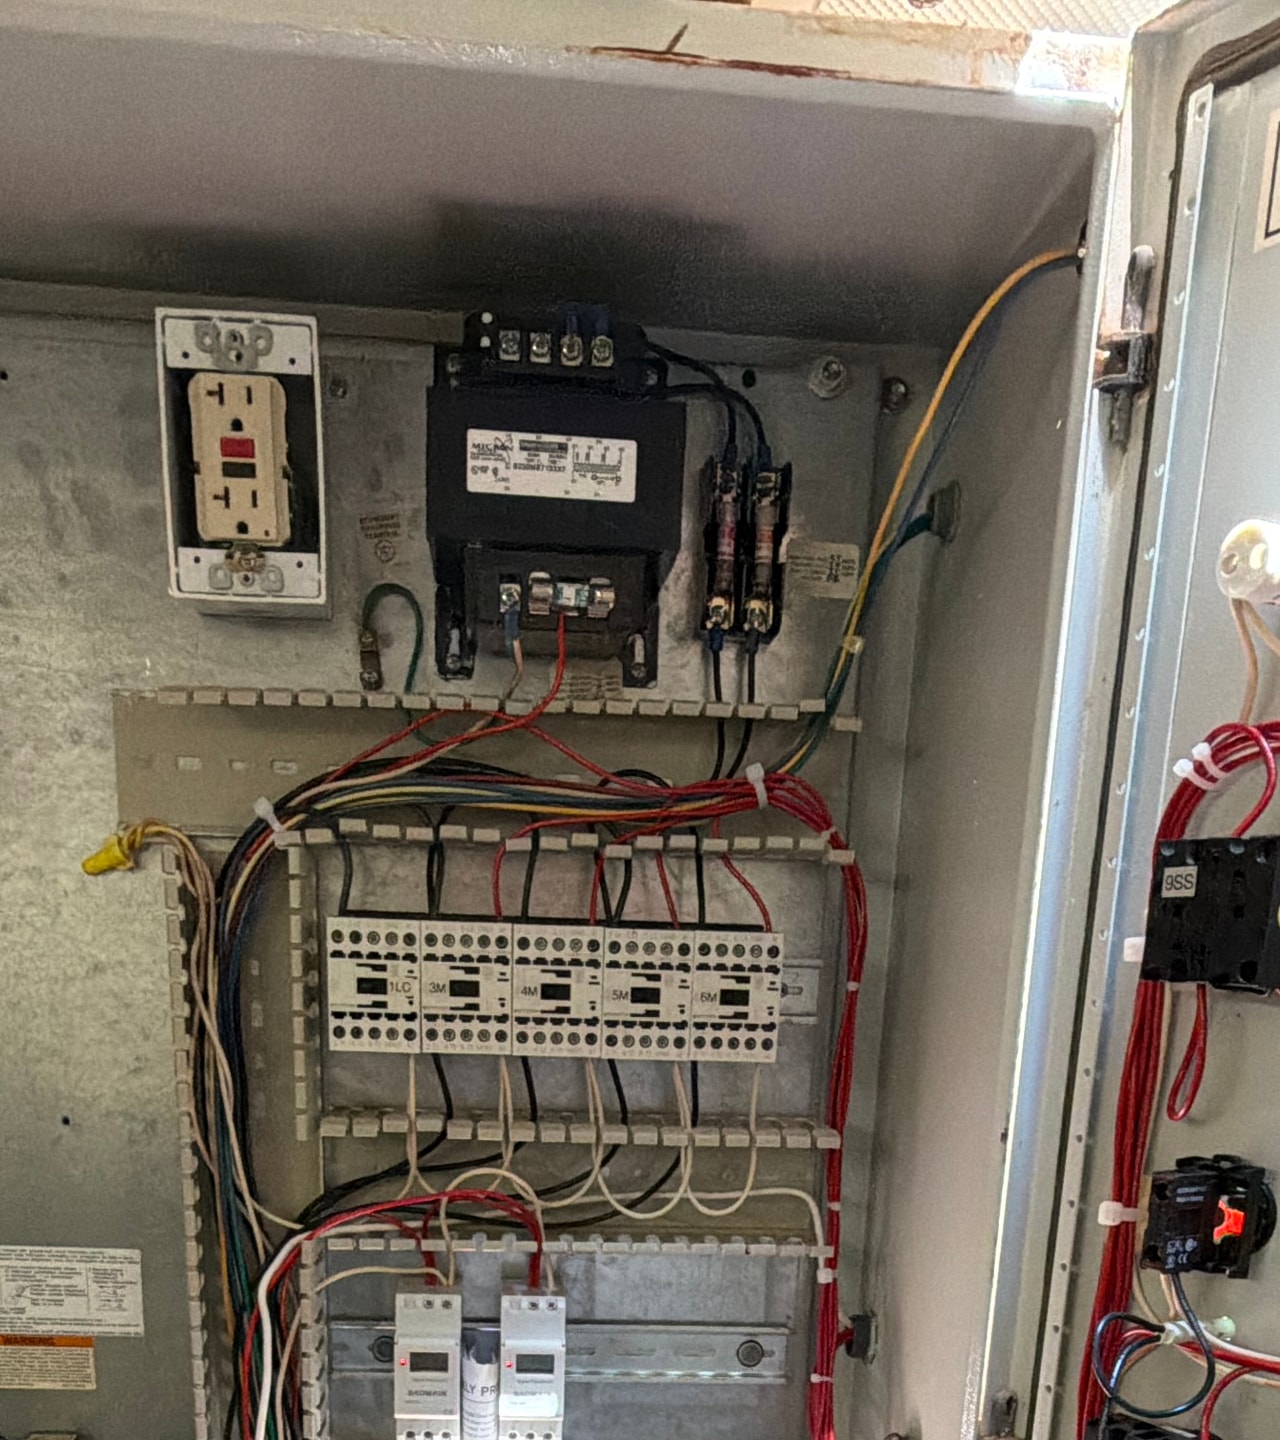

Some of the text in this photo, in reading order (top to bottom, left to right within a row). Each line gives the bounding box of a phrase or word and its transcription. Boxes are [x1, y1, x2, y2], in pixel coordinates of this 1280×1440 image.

[1164, 872, 1195, 891] 9SS
[428, 982, 447, 994] 3M
[520, 985, 538, 997] 4M
[611, 989, 630, 1001] 5M
[699, 991, 718, 1003] 6M
